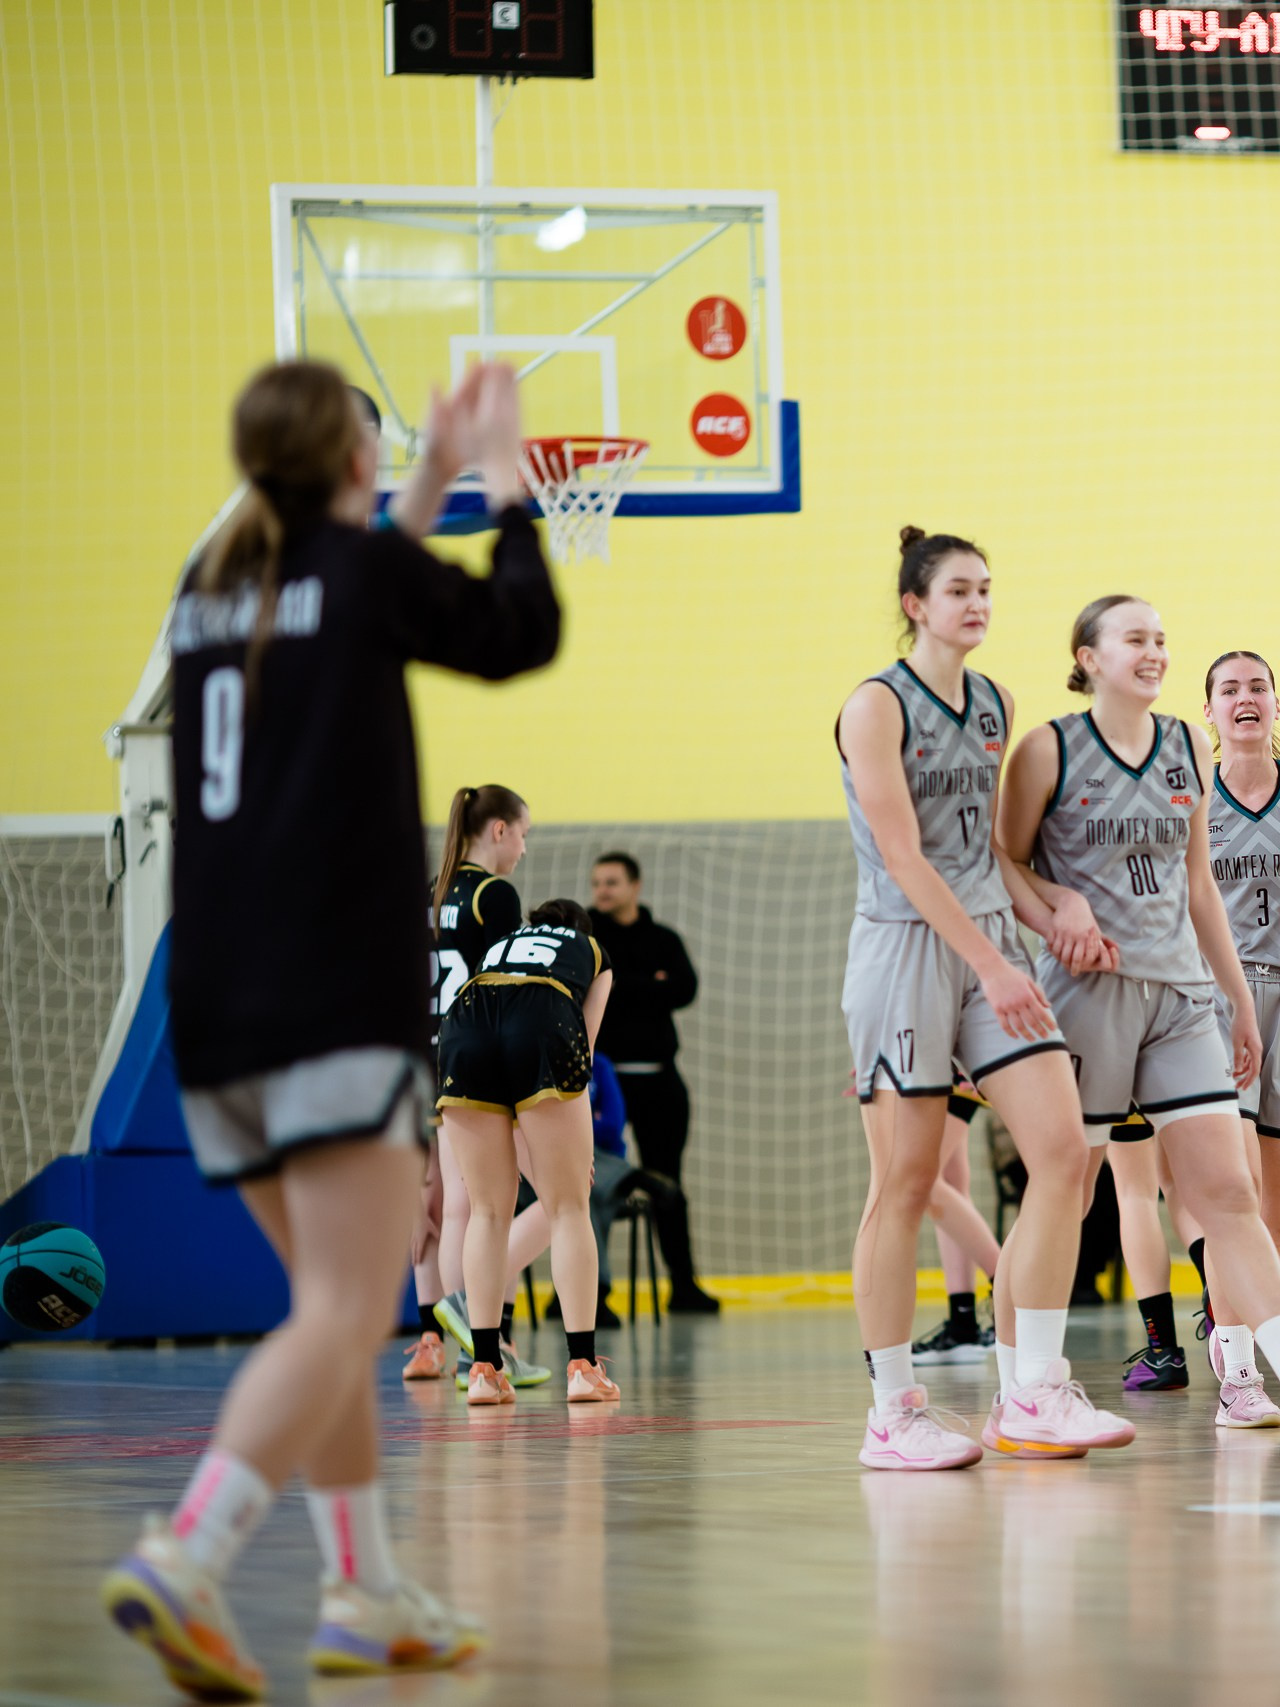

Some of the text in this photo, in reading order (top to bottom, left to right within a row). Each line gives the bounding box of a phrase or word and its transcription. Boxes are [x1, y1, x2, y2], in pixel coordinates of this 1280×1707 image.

[201, 665, 244, 822] 9
[918, 764, 998, 799] ПОЛИТЕХ ПЕТ
[957, 806, 979, 850] 17
[1086, 817, 1190, 846] ПОЛИТЕХ ПЕТР
[1126, 853, 1160, 896] 80
[1256, 888, 1269, 926] 3
[896, 1029, 914, 1074] 17
